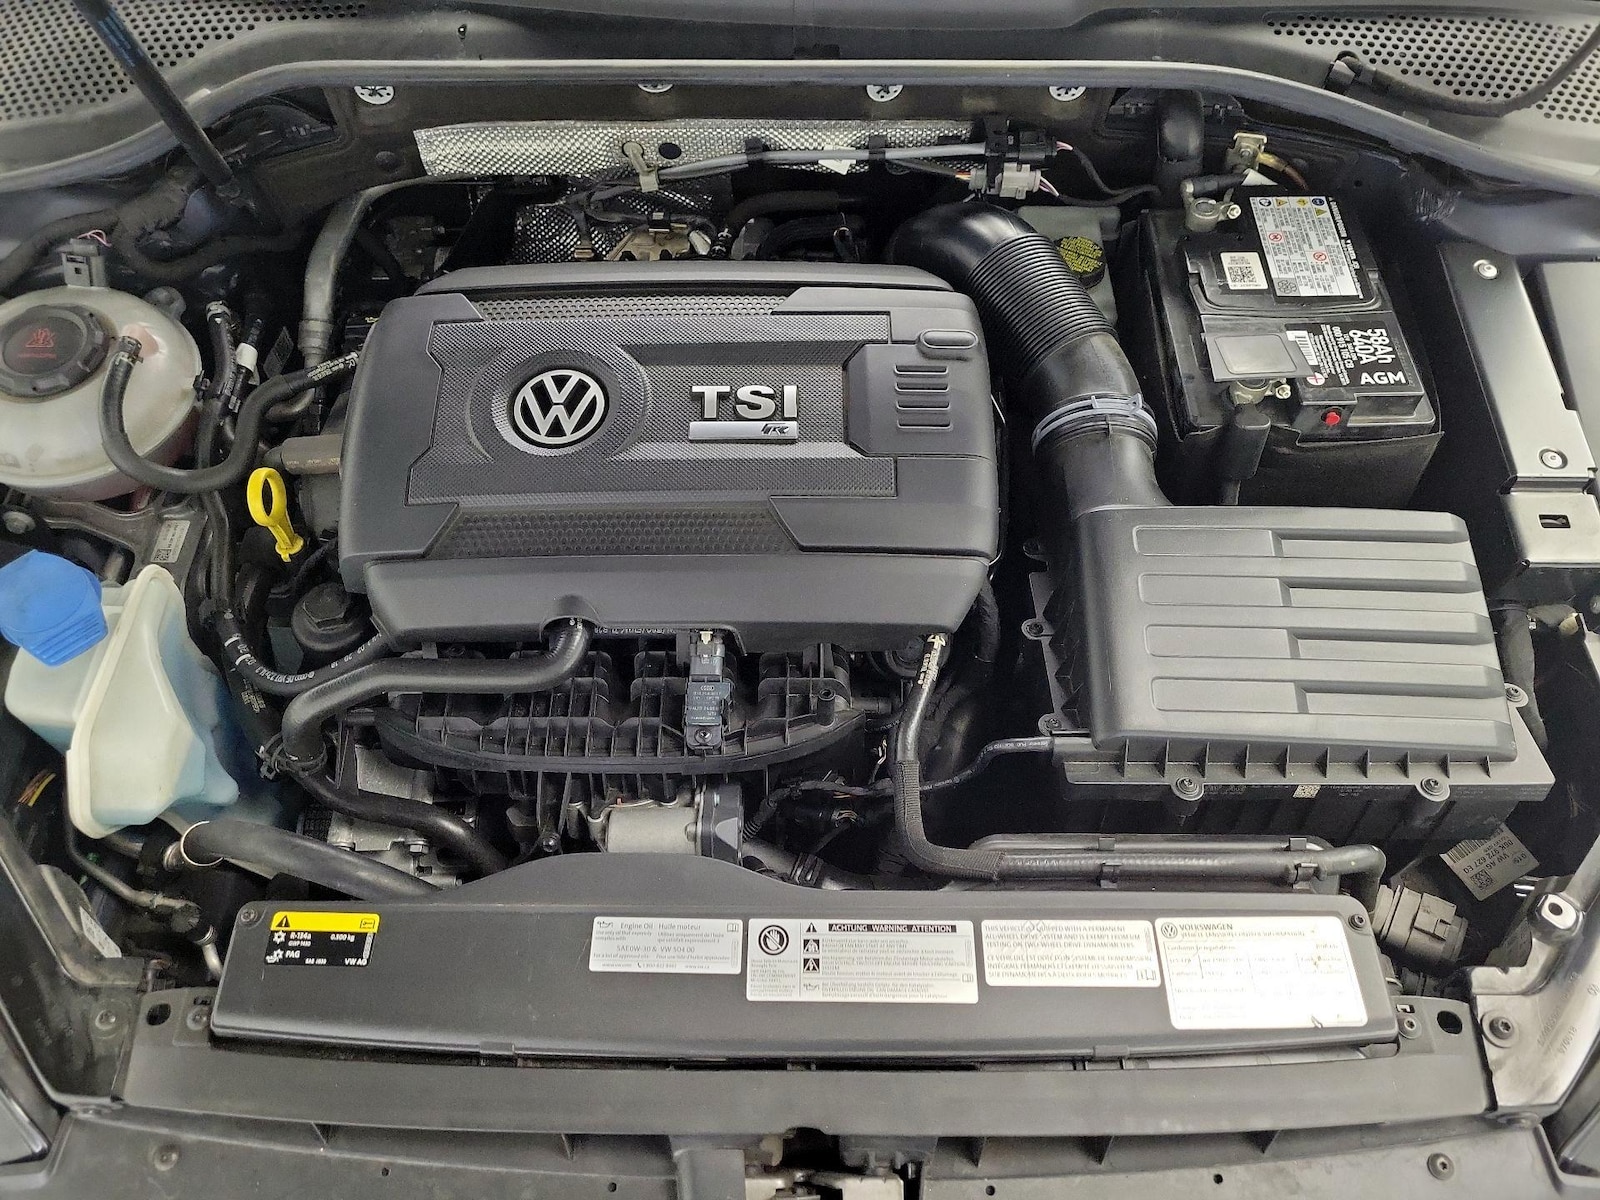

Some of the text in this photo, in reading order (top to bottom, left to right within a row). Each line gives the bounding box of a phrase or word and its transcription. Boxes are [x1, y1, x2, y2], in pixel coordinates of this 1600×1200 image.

[1332, 326, 1343, 338] 000
[1337, 338, 1347, 351] 915
[1349, 330, 1378, 364] 640A
[1368, 328, 1396, 364] 58Ah
[1360, 370, 1406, 385] AGM
[692, 385, 798, 420] TSI
[1474, 856, 1487, 868] 627
[1486, 852, 1510, 870] VW AG
[620, 922, 642, 930] Engine
[831, 924, 952, 932] ACHTUNG WARNING ATTENTION
[285, 950, 300, 958] PAG
